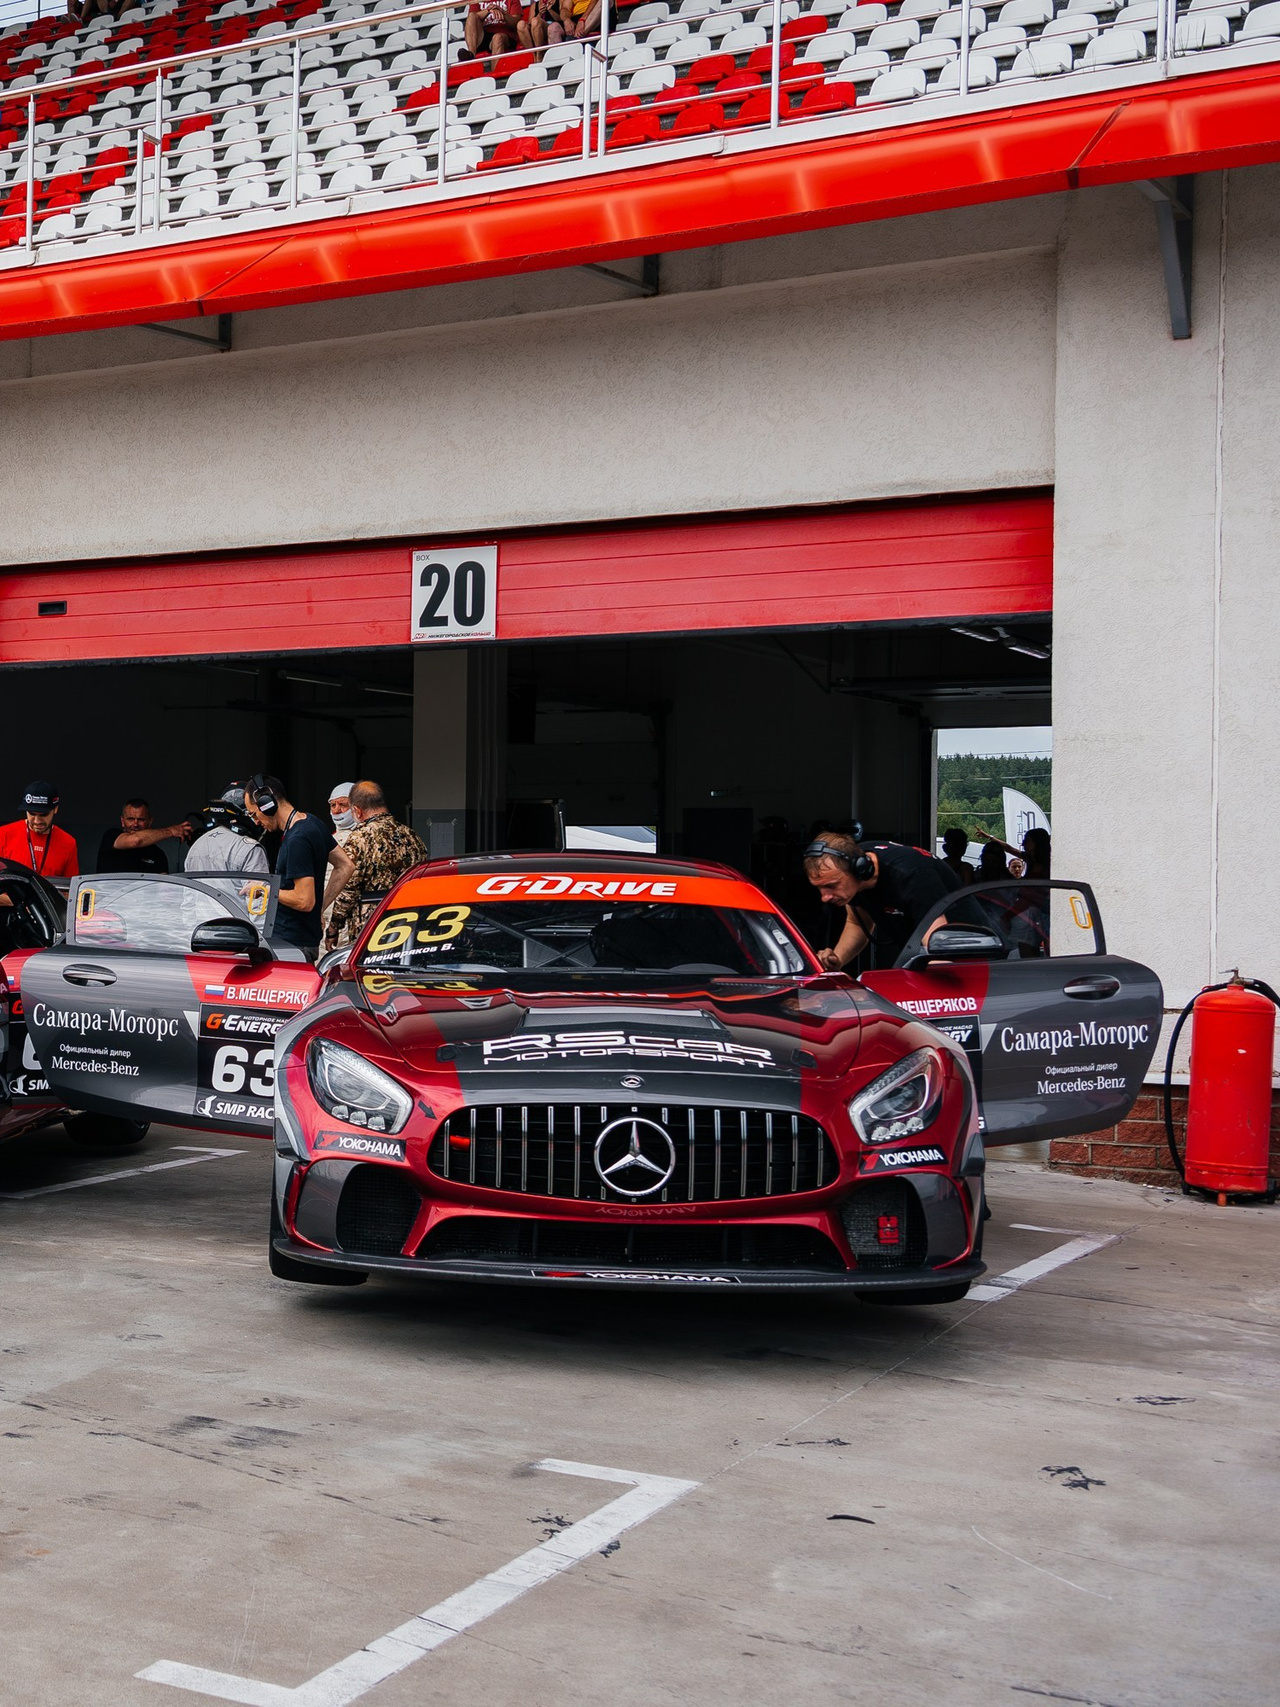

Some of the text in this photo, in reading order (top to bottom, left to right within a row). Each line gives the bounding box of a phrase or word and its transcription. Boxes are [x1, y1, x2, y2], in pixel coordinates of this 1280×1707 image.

[479, 0, 507, 11] THK
[416, 554, 430, 562] BOX
[419, 561, 486, 628] 20
[367, 905, 471, 952] 63
[363, 946, 438, 964] Мещеряков
[226, 986, 309, 1006] В.МЕЩЕРЯКО
[33, 1003, 179, 1042] Самара-Моторс
[206, 1013, 283, 1037] G-ENERG
[483, 1030, 772, 1060] RSCAR
[1001, 1021, 1149, 1055] Самара-Моторс
[60, 1043, 131, 1059] Официальный дилер
[484, 1048, 776, 1068] MOTORSPORT
[51, 1056, 140, 1077] Mercedes-Benz
[211, 1045, 275, 1097] 63
[1045, 1062, 1118, 1076] Официальный дилер
[28, 1079, 51, 1091] SM
[1037, 1076, 1126, 1095] Mercedes-Benz
[214, 1102, 246, 1115] SMP
[337, 1136, 402, 1157] YOKOHAMA
[879, 1149, 944, 1167] YOKOHAMA
[586, 1272, 731, 1283] YOKOHAMA
